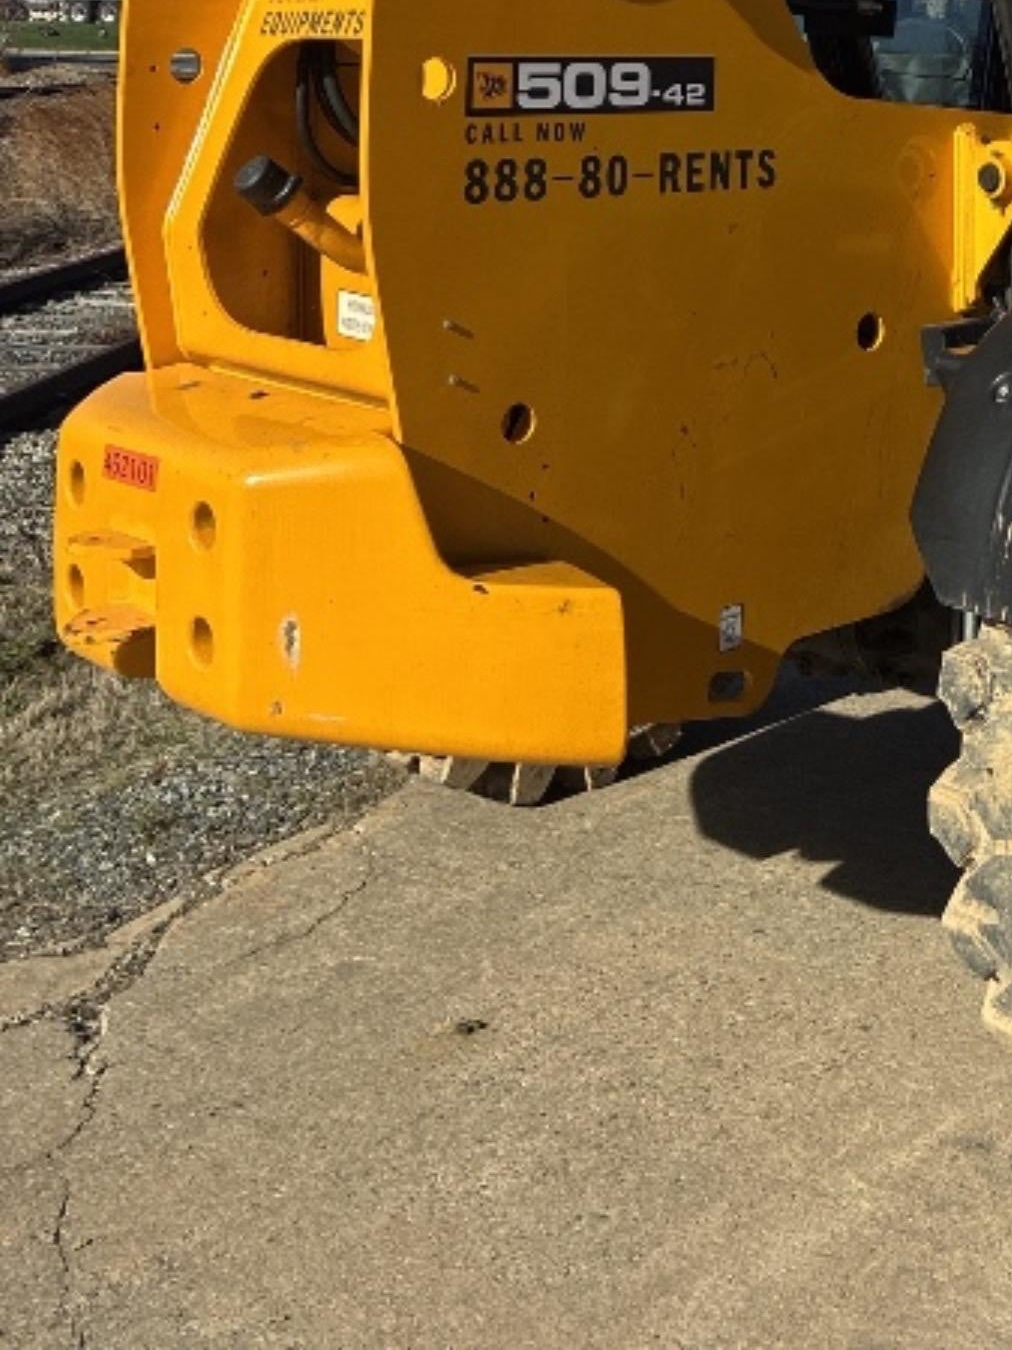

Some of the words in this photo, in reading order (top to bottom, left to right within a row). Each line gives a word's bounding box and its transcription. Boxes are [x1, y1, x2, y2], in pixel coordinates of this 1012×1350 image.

[465, 123, 524, 144] CALL
[536, 122, 586, 142] NOW
[465, 150, 777, 204] 888-80-RENTS
